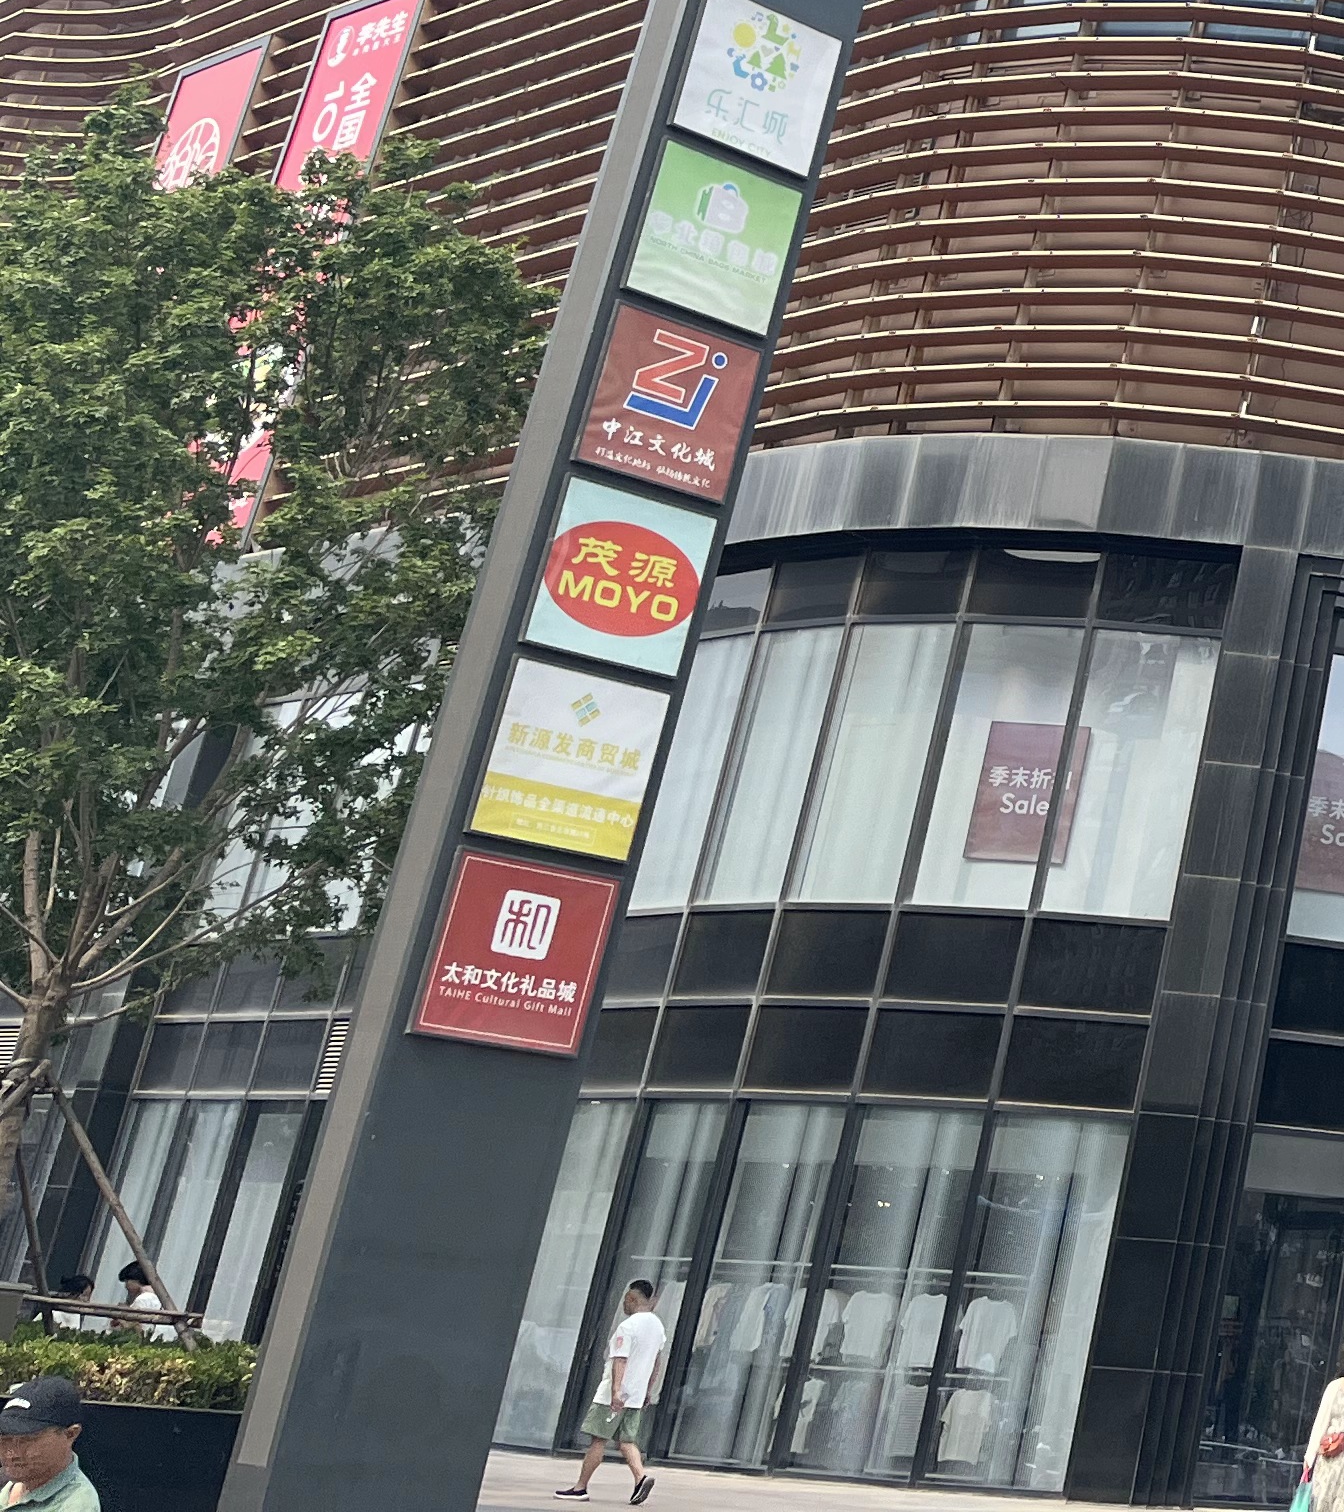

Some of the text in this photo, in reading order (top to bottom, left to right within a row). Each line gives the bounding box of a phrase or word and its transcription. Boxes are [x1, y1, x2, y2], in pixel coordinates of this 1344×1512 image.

[332, 71, 377, 151] 全国
[704, 88, 790, 145] 乐汇城
[711, 127, 771, 158] ENJOY CITY
[602, 418, 716, 472] 中江文化城
[571, 536, 678, 588] 茂源
[557, 569, 679, 622] MOYO
[507, 721, 642, 771] 新源发商贸城
[1000, 792, 1050, 816] Sale
[439, 985, 573, 1017] TAIHE Cultural Gift Mall
[441, 961, 578, 1003] 太和文化礼品城
